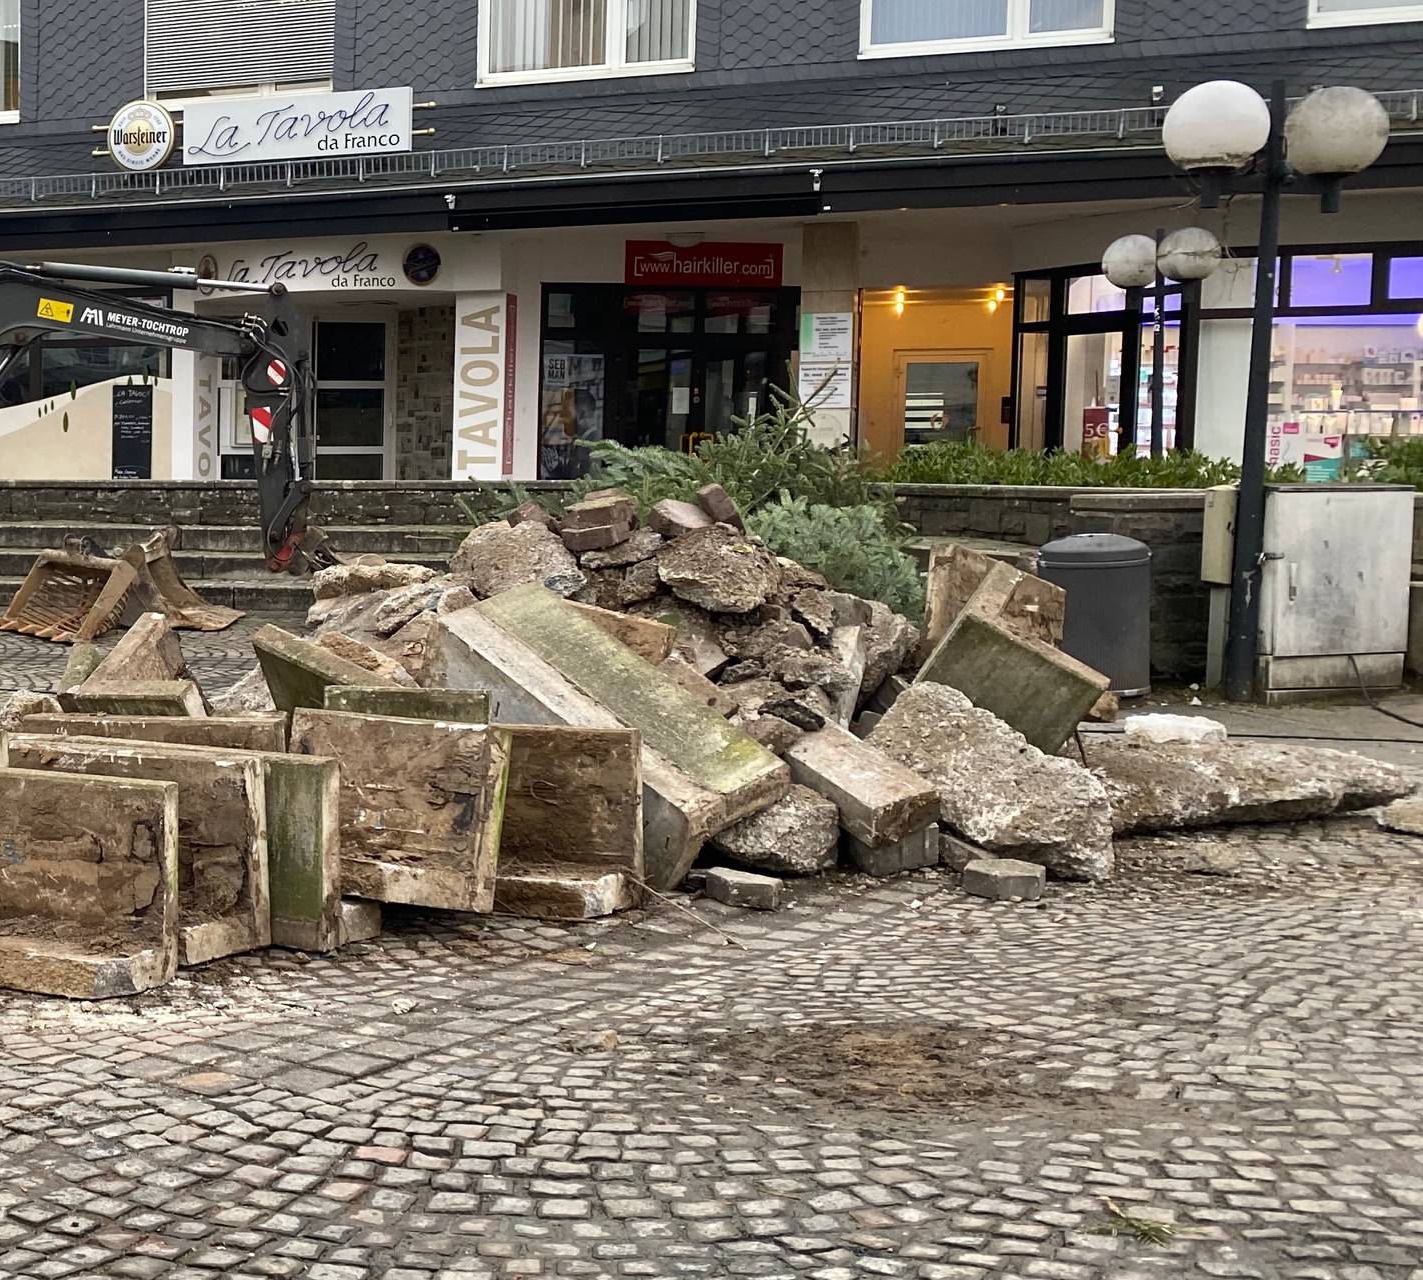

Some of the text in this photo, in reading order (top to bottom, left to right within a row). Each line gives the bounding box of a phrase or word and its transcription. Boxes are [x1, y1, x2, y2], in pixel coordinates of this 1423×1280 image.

[187, 91, 390, 157] La Tavola
[113, 126, 167, 147] Warsteiner
[317, 132, 400, 151] da Franco
[260, 241, 379, 285] Tavola
[331, 274, 396, 288] da Franco
[107, 311, 189, 337] MEYER-TOCHTROP
[548, 358, 566, 370] SEB
[547, 369, 566, 380] MAN
[457, 305, 500, 470] TAVOLA
[1084, 422, 1108, 437] 5€
